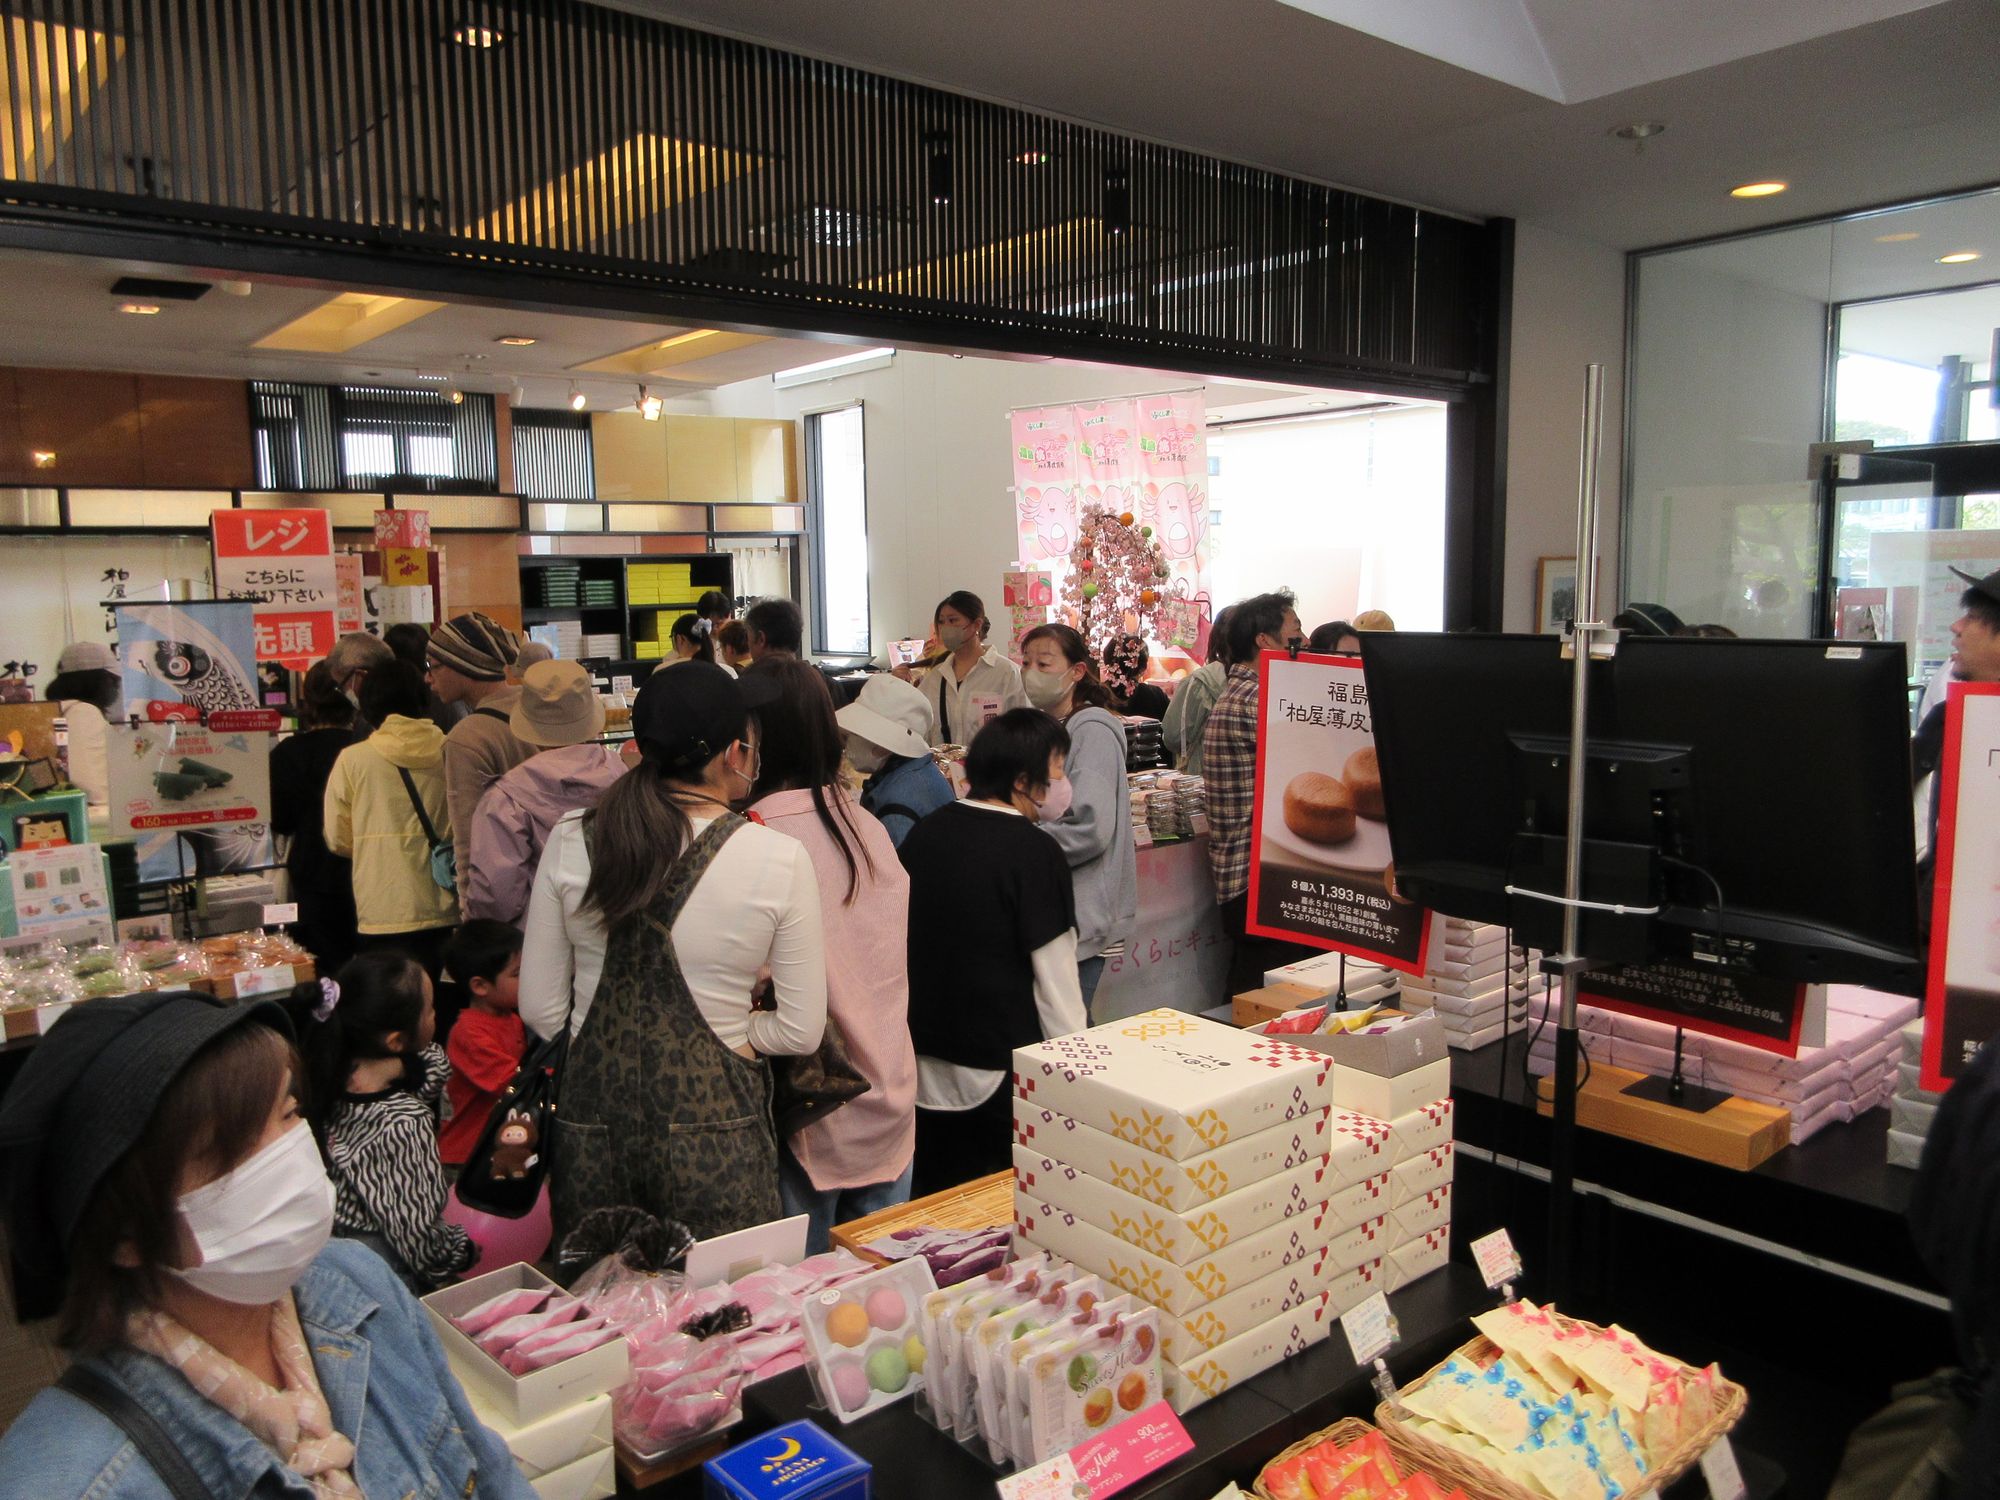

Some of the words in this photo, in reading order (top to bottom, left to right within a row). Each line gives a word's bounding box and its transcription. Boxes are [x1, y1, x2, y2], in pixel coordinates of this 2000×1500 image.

[245, 518, 309, 551] レジ
[245, 569, 305, 585] こちらに
[228, 588, 324, 604] お並び下さい
[254, 621, 315, 655] 先頭
[1328, 681, 1370, 706] 福島
[1279, 698, 1375, 734] 「柏屋薄皮
